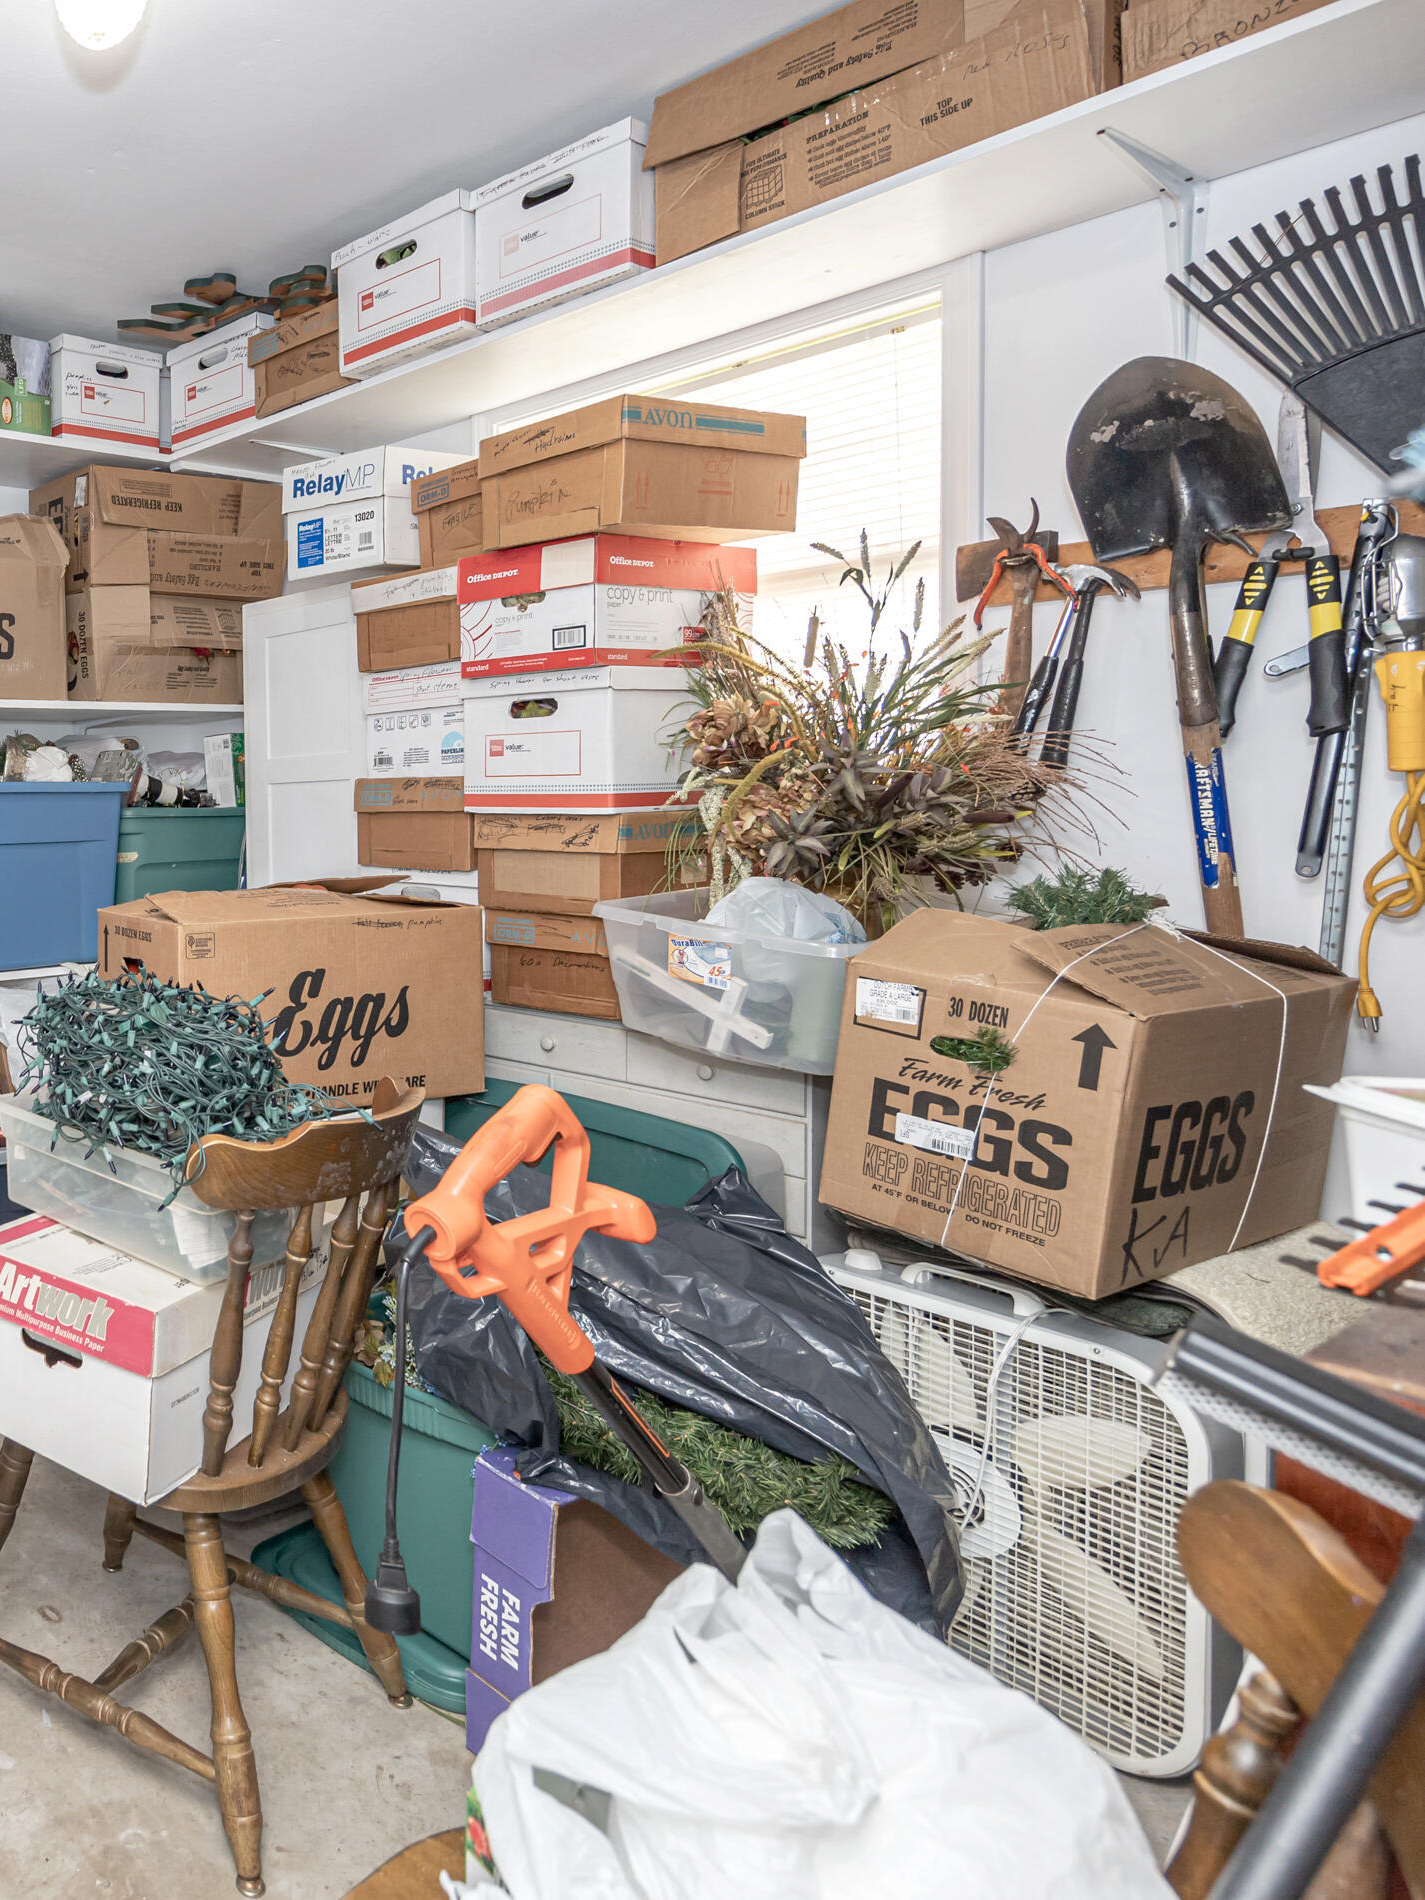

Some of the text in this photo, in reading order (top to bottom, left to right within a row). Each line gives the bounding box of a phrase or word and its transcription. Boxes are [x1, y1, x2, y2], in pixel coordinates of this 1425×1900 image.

[796, 70, 825, 88] Quality
[828, 62, 844, 76] and
[919, 98, 974, 127] THIS SIDE UP
[937, 97, 953, 110] TOP
[807, 110, 869, 144] PREPARATION
[642, 407, 694, 430] AVON
[293, 464, 375, 498] RelayMP
[111, 495, 183, 513] REFRIGERATED KEEP
[355, 510, 375, 522] 13020
[325, 533, 342, 541] LETTER
[610, 556, 655, 568] Office DEPOT
[165, 573, 186, 586] Safety
[467, 572, 492, 584] Office
[493, 569, 519, 580] DEPOT
[607, 587, 636, 606] copy
[647, 588, 673, 608] print
[495, 613, 511, 625] copy
[516, 611, 533, 622] print
[79, 611, 89, 679] 30 DOZEN EGGS
[607, 653, 628, 661] standard
[466, 664, 489, 673] standard
[1194, 761, 1216, 828] RAFTSMAN
[115, 925, 152, 943] 30 DOZEN EGGS
[497, 928, 607, 946] ORM-D AVO
[273, 968, 410, 1071] Eggs
[948, 996, 1009, 1028] 30 DOZEN
[899, 1058, 1047, 1111] Farm Fresh
[867, 1076, 1073, 1191] EGGS
[1131, 1090, 1255, 1204] EGGS
[862, 1142, 1063, 1238] KEEP REFRIGERATED
[871, 1182, 883, 1192] AT
[905, 1194, 919, 1205] OR
[921, 1198, 954, 1216] BELOW
[965, 1213, 1046, 1247] DO NOT FREEZE
[16, 1309, 55, 1332] Multipurpose
[55, 1325, 83, 1345] Business
[84, 1338, 105, 1353] Paper
[480, 1572, 499, 1661] FRESH
[500, 1588, 521, 1671] FARM
